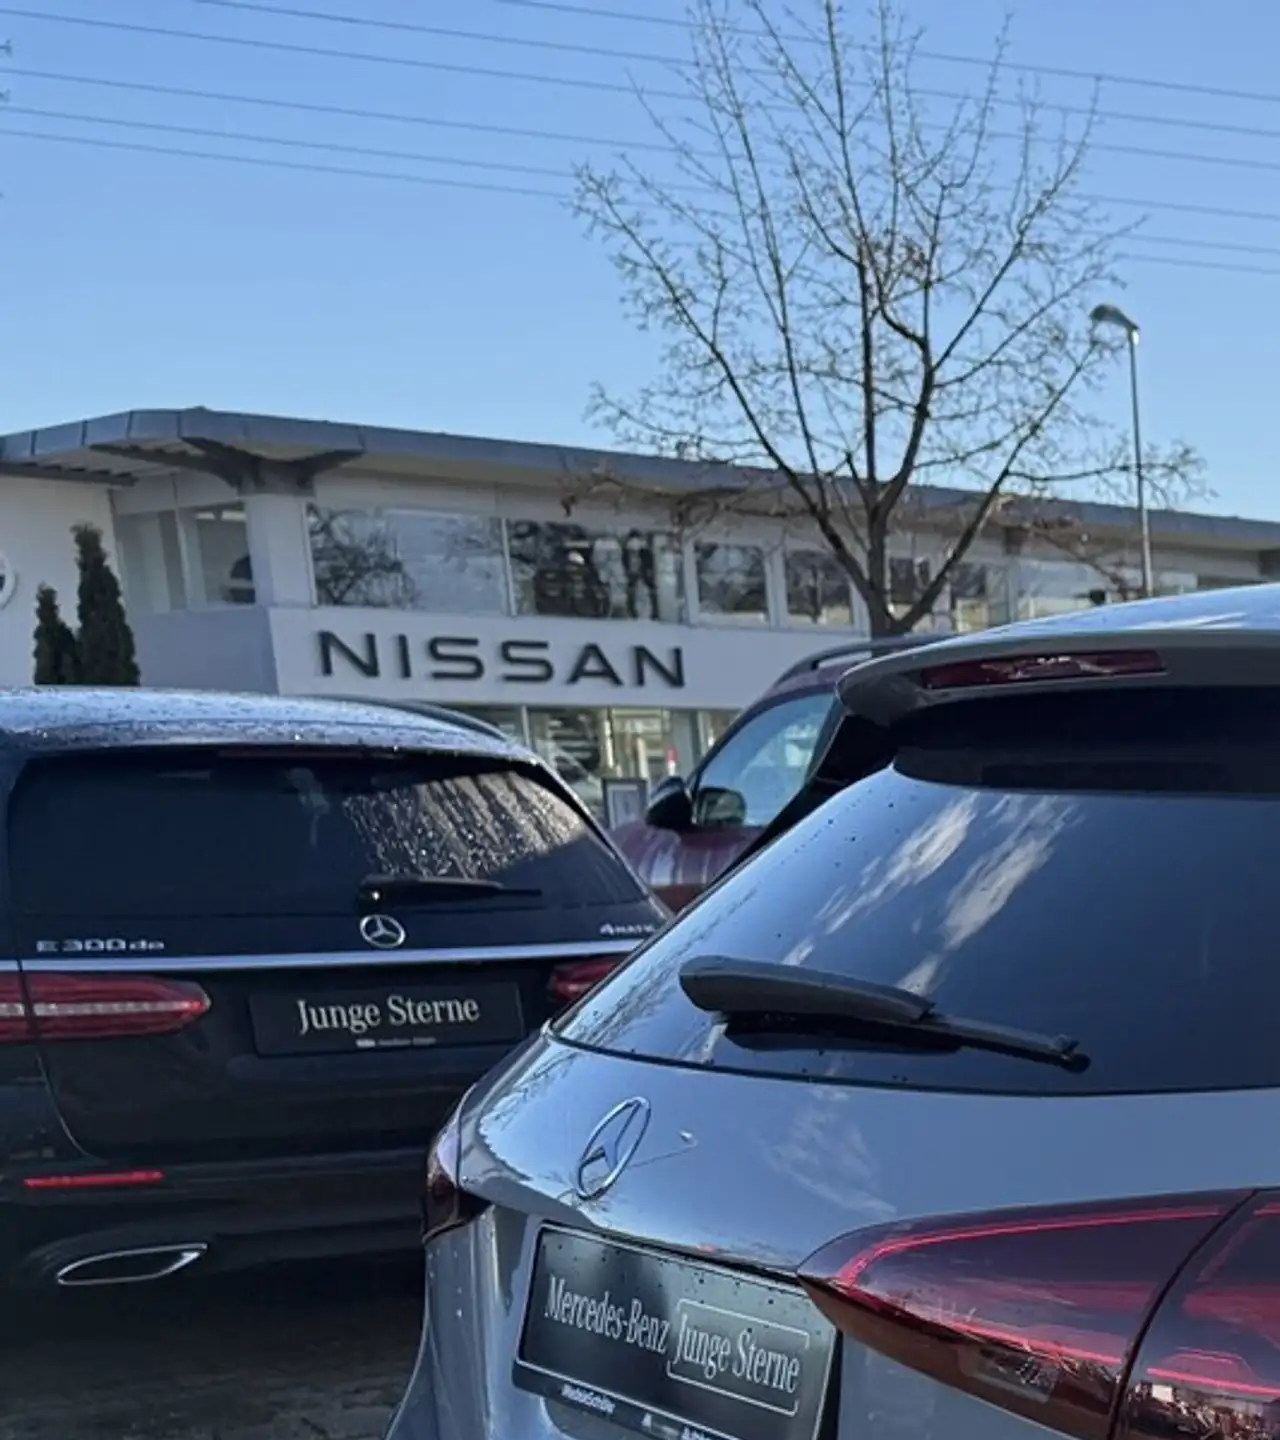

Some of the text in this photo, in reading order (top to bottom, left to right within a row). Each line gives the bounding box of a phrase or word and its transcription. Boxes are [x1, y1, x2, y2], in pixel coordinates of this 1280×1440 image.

[318, 630, 685, 688] NISSAN
[61, 938, 126, 952] 300
[297, 994, 480, 1035] Junge Sterne
[544, 1276, 800, 1394] Mercedes-Benz Junge Sterne
